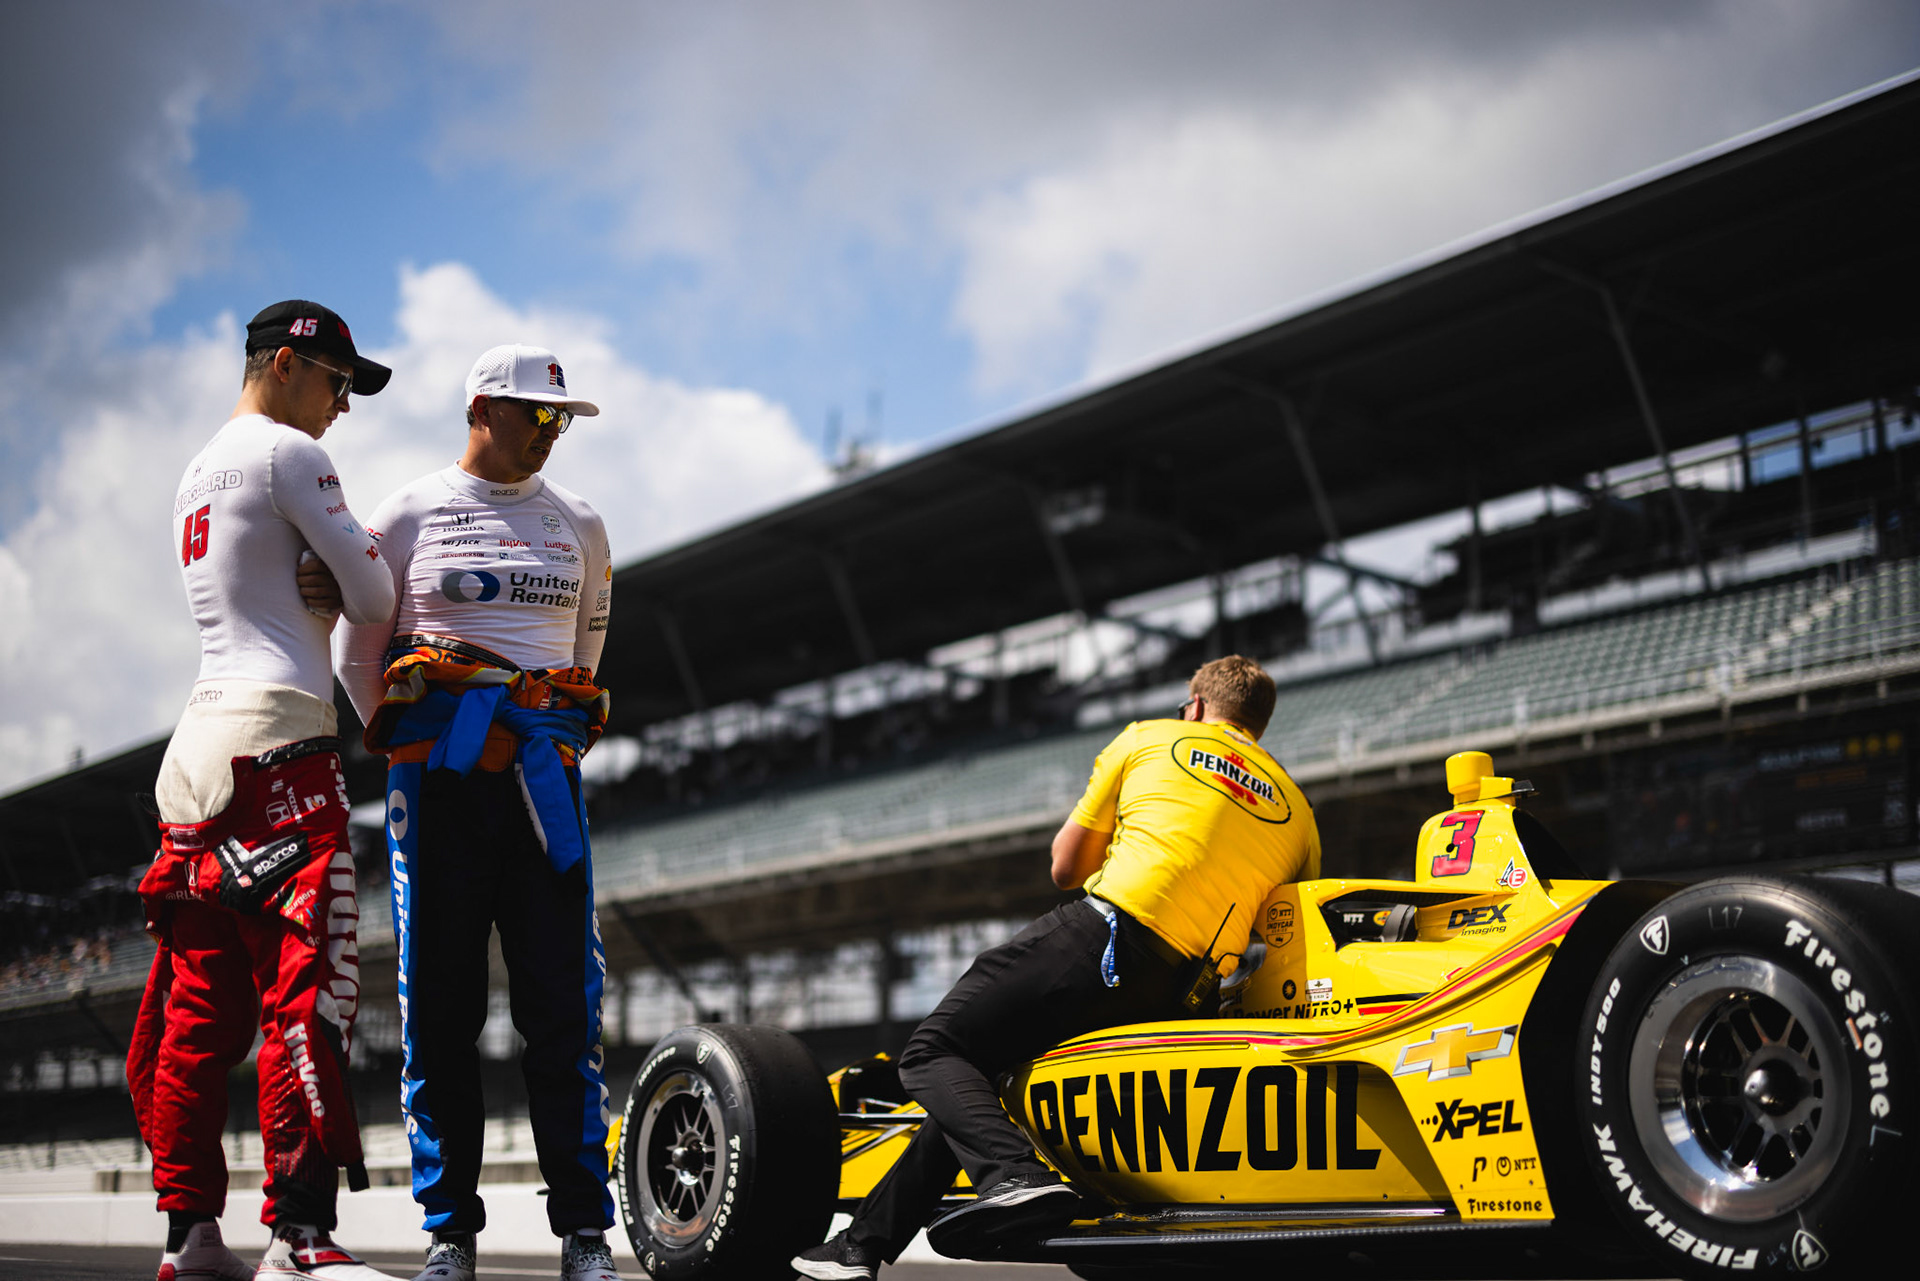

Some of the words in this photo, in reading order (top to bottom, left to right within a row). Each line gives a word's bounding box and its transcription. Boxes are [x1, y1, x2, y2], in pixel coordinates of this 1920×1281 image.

[289, 318, 318, 336] 45
[489, 488, 520, 496] sparco
[182, 504, 210, 568] 45
[510, 572, 580, 593] United
[1189, 748, 1276, 804] PENNZOIL
[253, 842, 298, 876] sparco
[1431, 810, 1485, 878] 3
[1266, 920, 1294, 930] INDYCAR
[1447, 903, 1512, 930] DEX
[1460, 925, 1507, 936] imaging
[1596, 977, 1622, 1035] 500
[1784, 919, 1891, 1119] Firestone
[1590, 1034, 1604, 1106] INDY
[1030, 1064, 1382, 1173] PENNZOIL
[1432, 1098, 1523, 1142] XPEL
[1513, 1157, 1537, 1171] NTT
[705, 1134, 741, 1252] Firestone
[1467, 1198, 1543, 1215] Firestone
[1593, 1122, 1760, 1270] FIREHAWK
